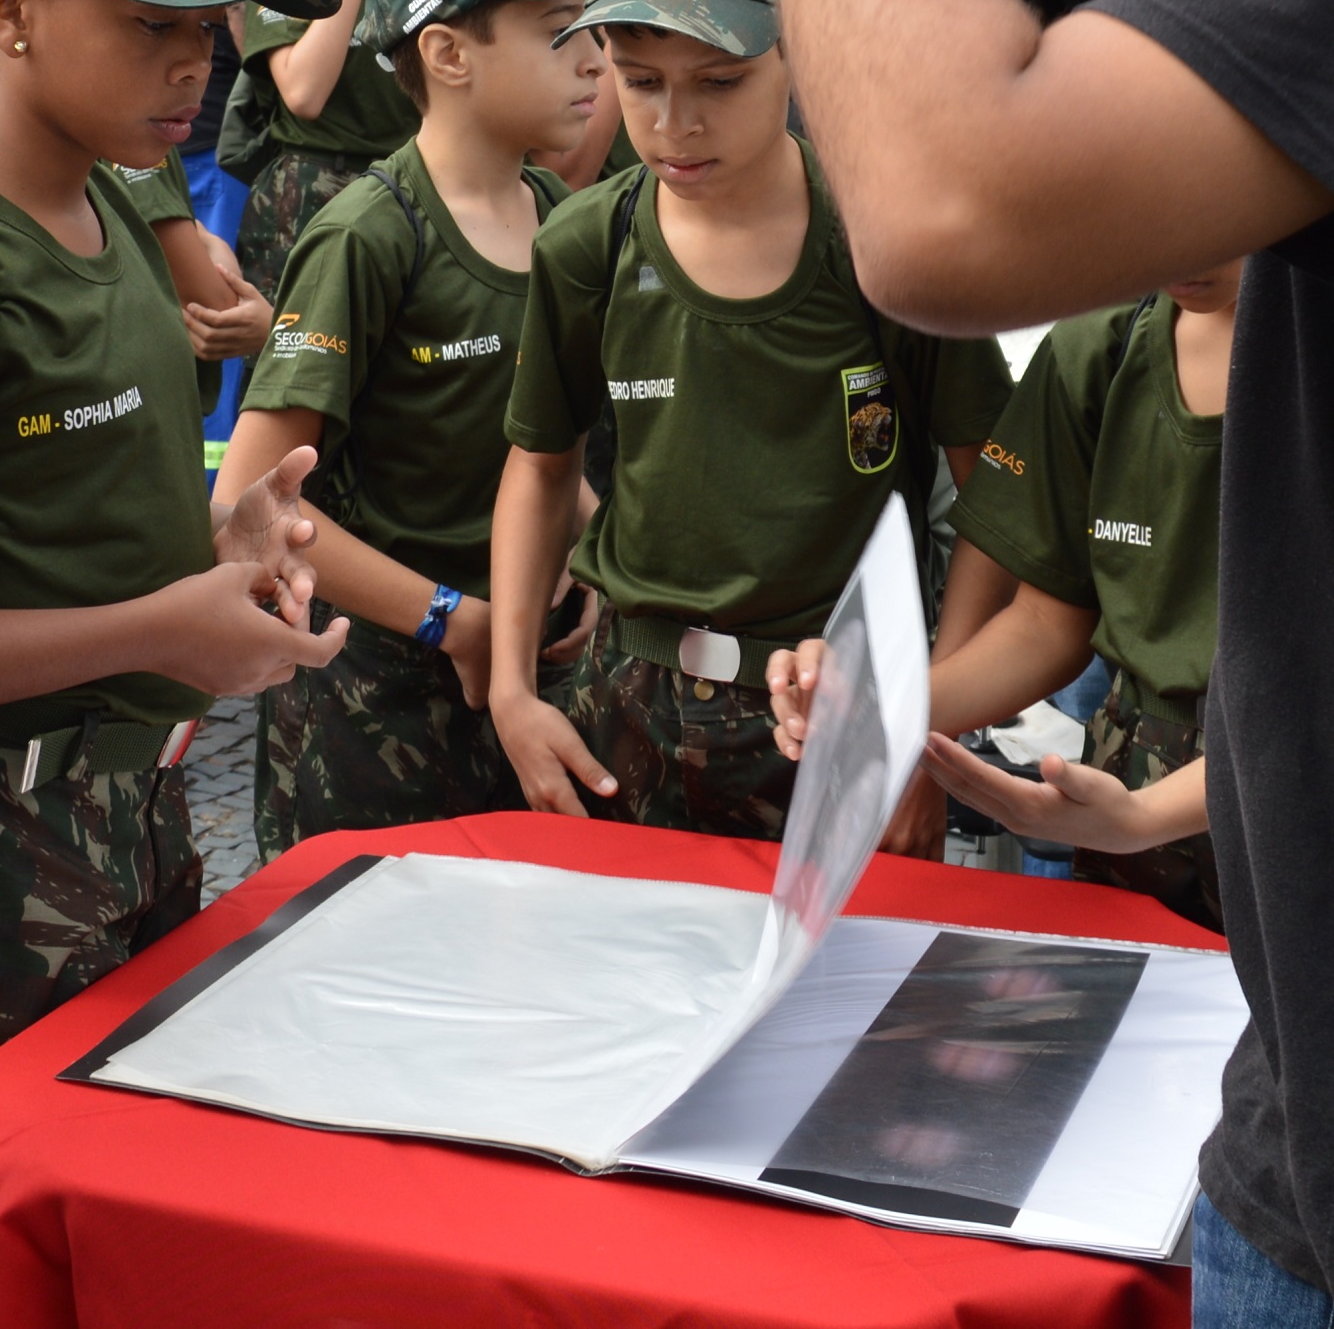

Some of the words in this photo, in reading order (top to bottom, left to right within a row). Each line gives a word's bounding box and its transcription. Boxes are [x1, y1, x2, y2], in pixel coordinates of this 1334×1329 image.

[442, 334, 502, 362] MATHEUS
[630, 377, 675, 399] HENRIQUE
[18, 413, 51, 437] GAM
[64, 400, 114, 431] SOPHIA
[113, 385, 143, 418] MARIA
[1094, 518, 1153, 547] DANYELLE
